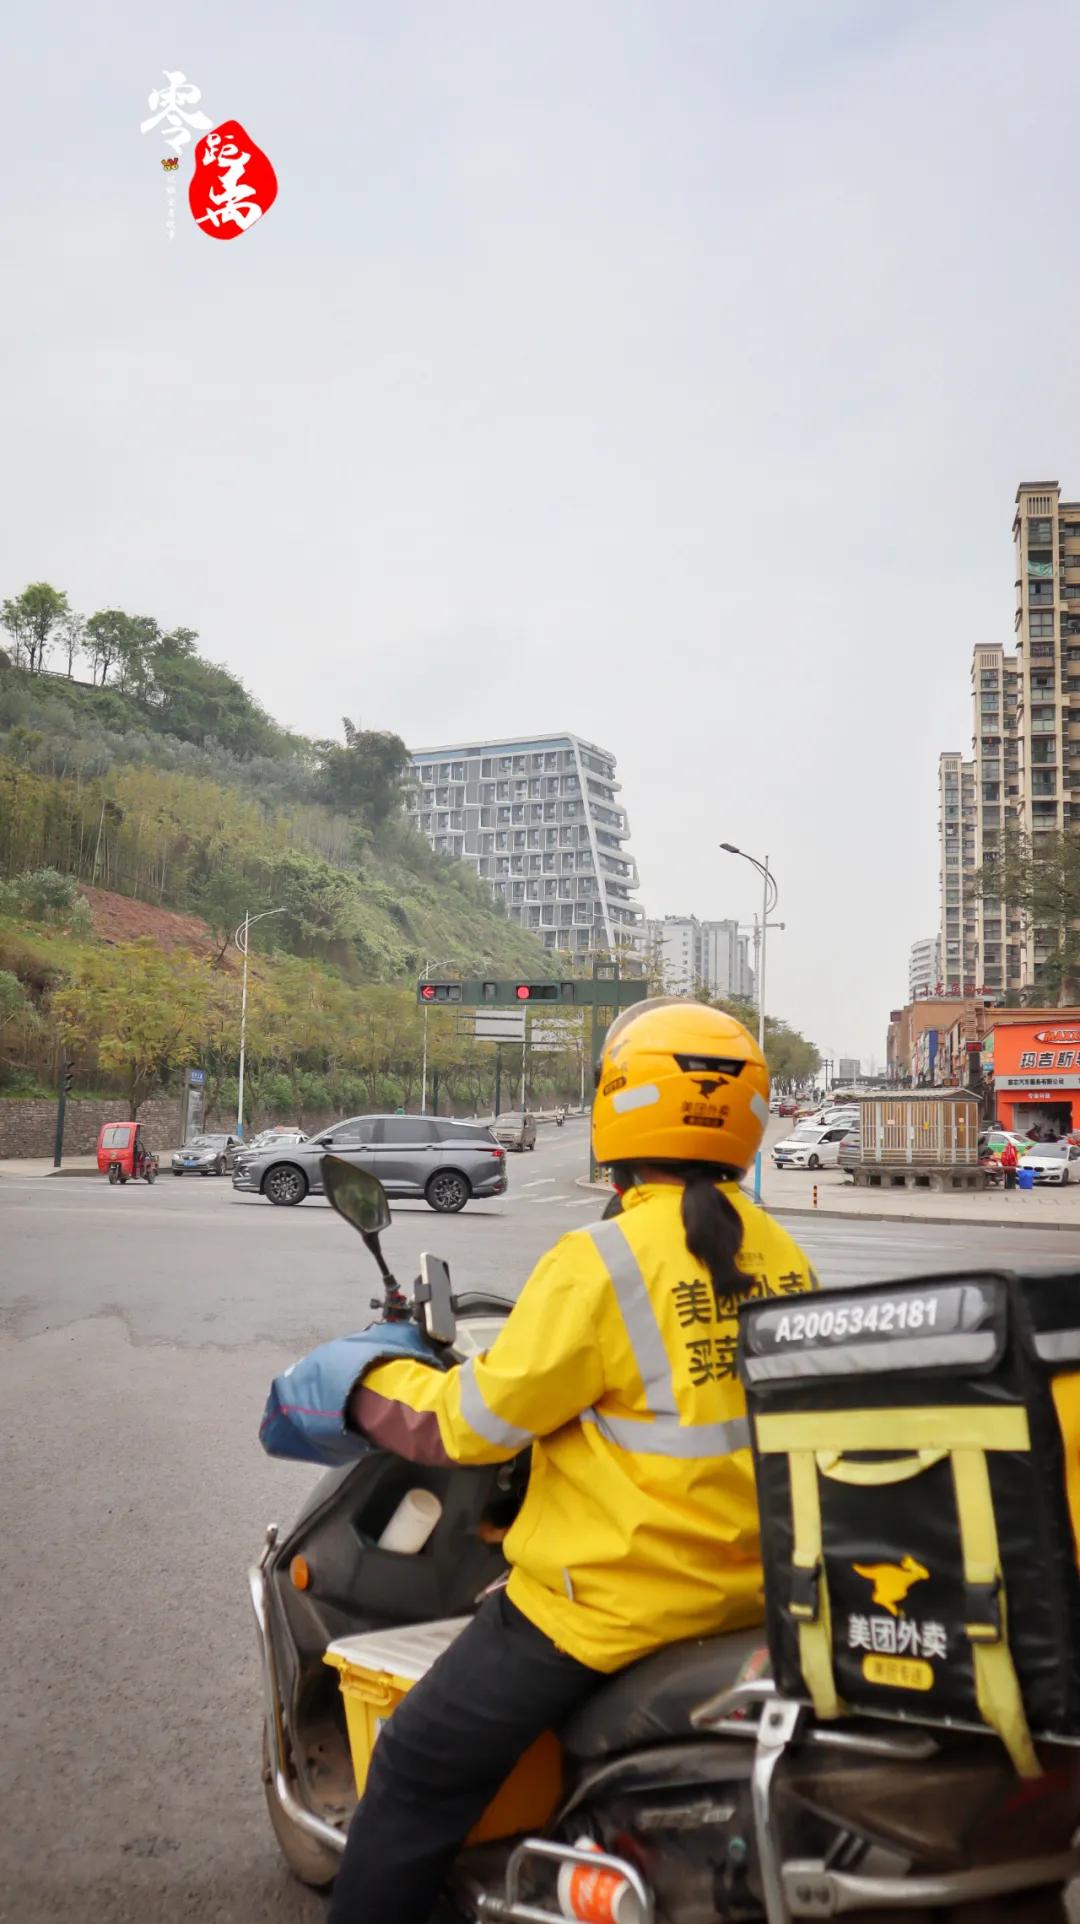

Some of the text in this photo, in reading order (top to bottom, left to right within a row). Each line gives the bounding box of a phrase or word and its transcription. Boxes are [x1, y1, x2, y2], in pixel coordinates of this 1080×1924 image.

[1020, 1051, 1080, 1069] 玛吉斯
[774, 1298, 939, 1343] A2005342181
[847, 1613, 947, 1660] 美团外卖
